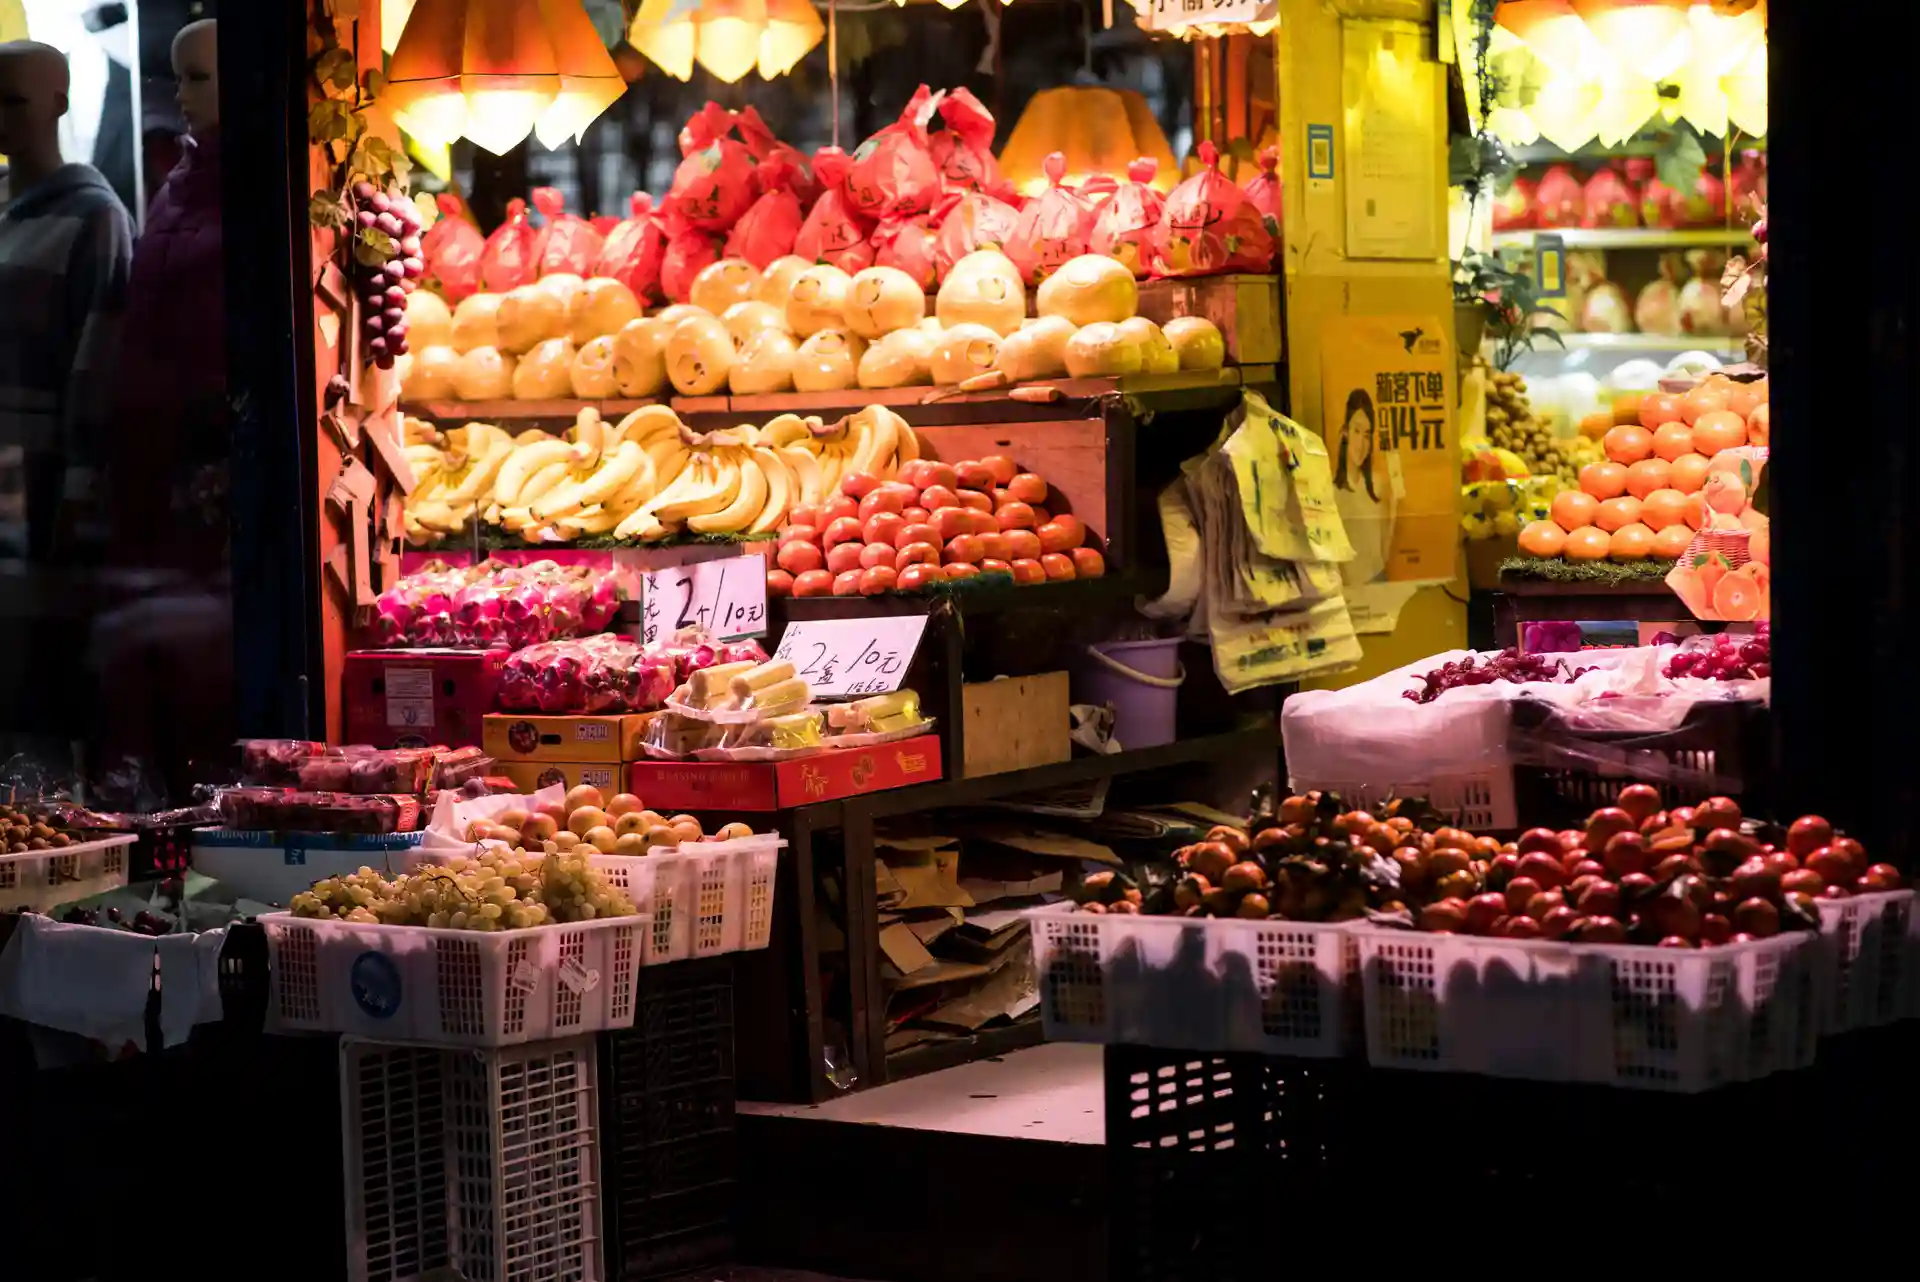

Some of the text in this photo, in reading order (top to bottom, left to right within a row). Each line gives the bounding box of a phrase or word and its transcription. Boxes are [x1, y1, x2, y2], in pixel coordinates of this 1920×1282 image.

[1376, 371, 1443, 404] 新客下单
[1390, 405, 1445, 450] 14元
